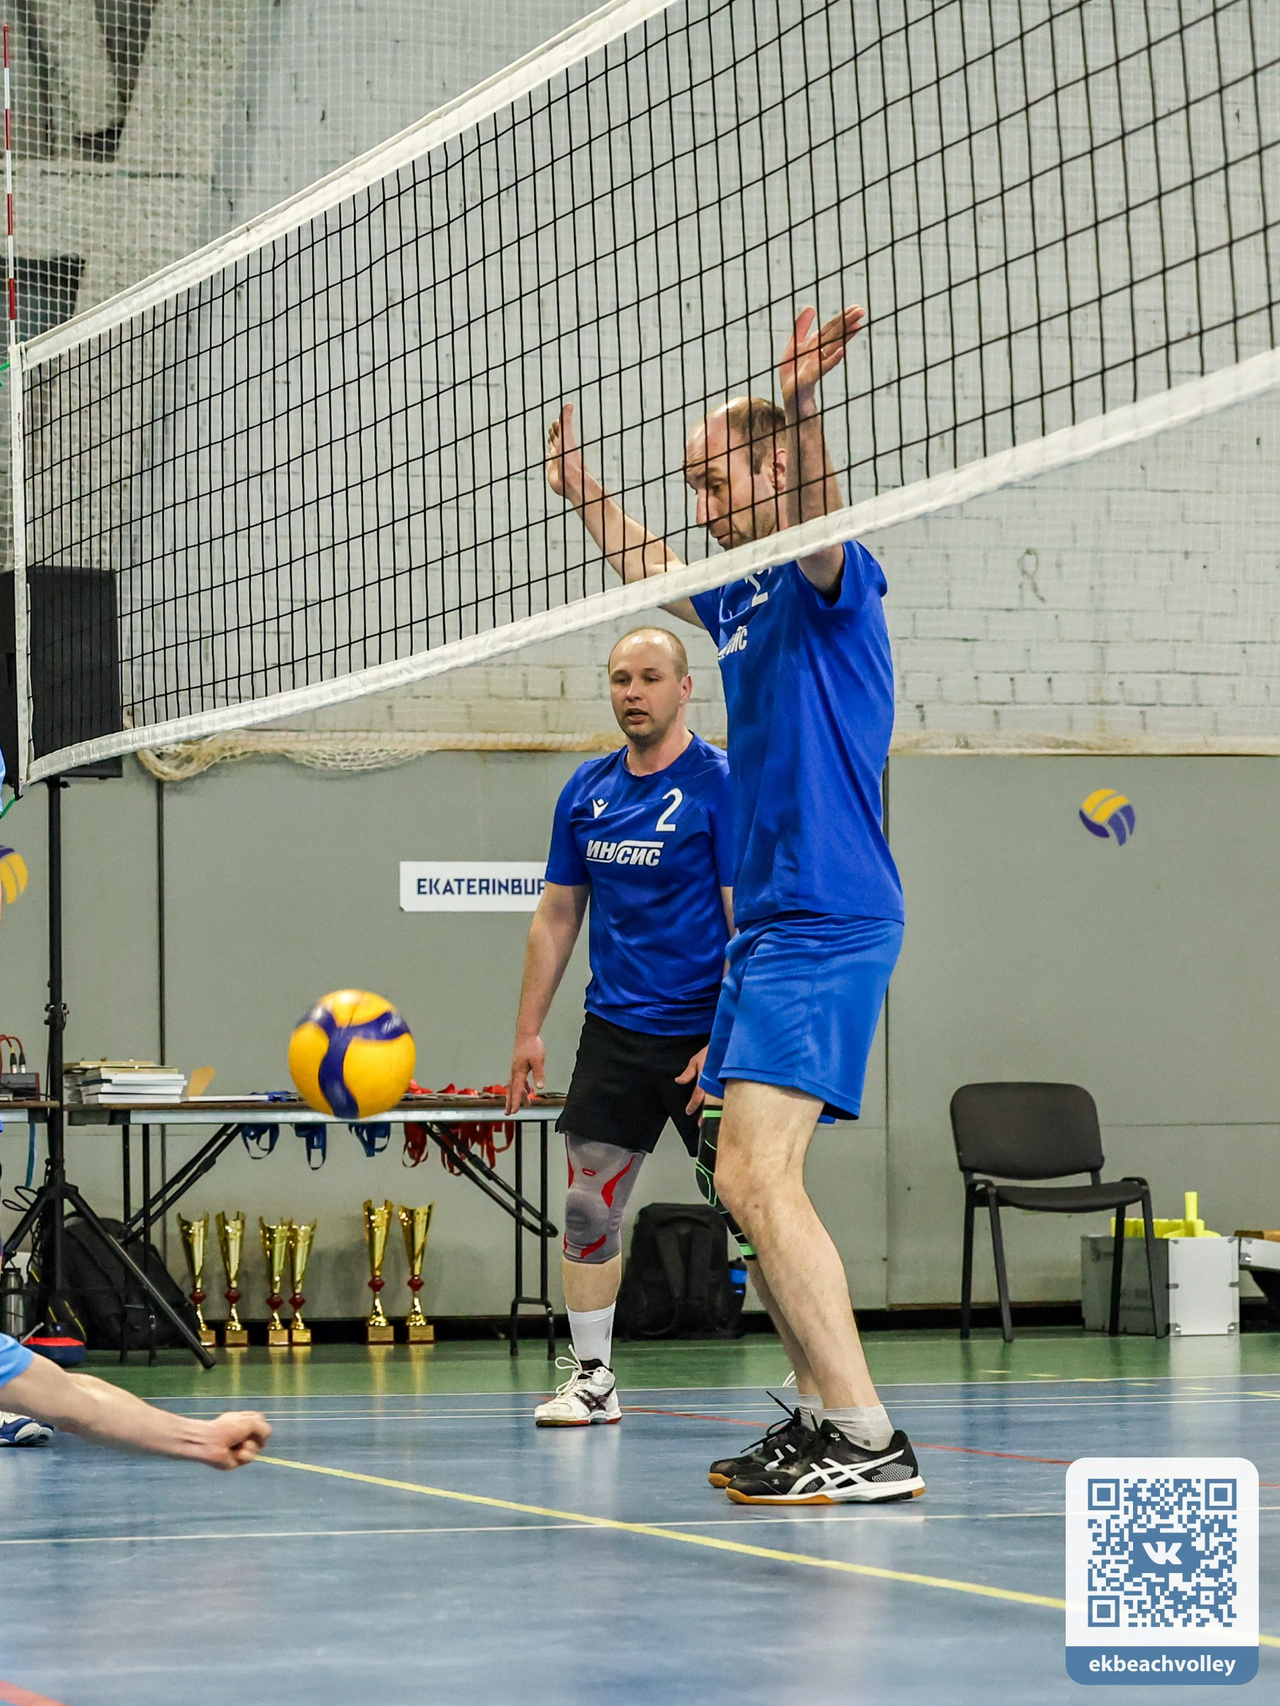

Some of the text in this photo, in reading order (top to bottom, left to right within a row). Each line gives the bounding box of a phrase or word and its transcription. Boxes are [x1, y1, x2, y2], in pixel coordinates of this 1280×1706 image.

[655, 788, 683, 832] 2
[586, 840, 664, 867] ИНСИС
[417, 878, 546, 895] EKATERINBUR
